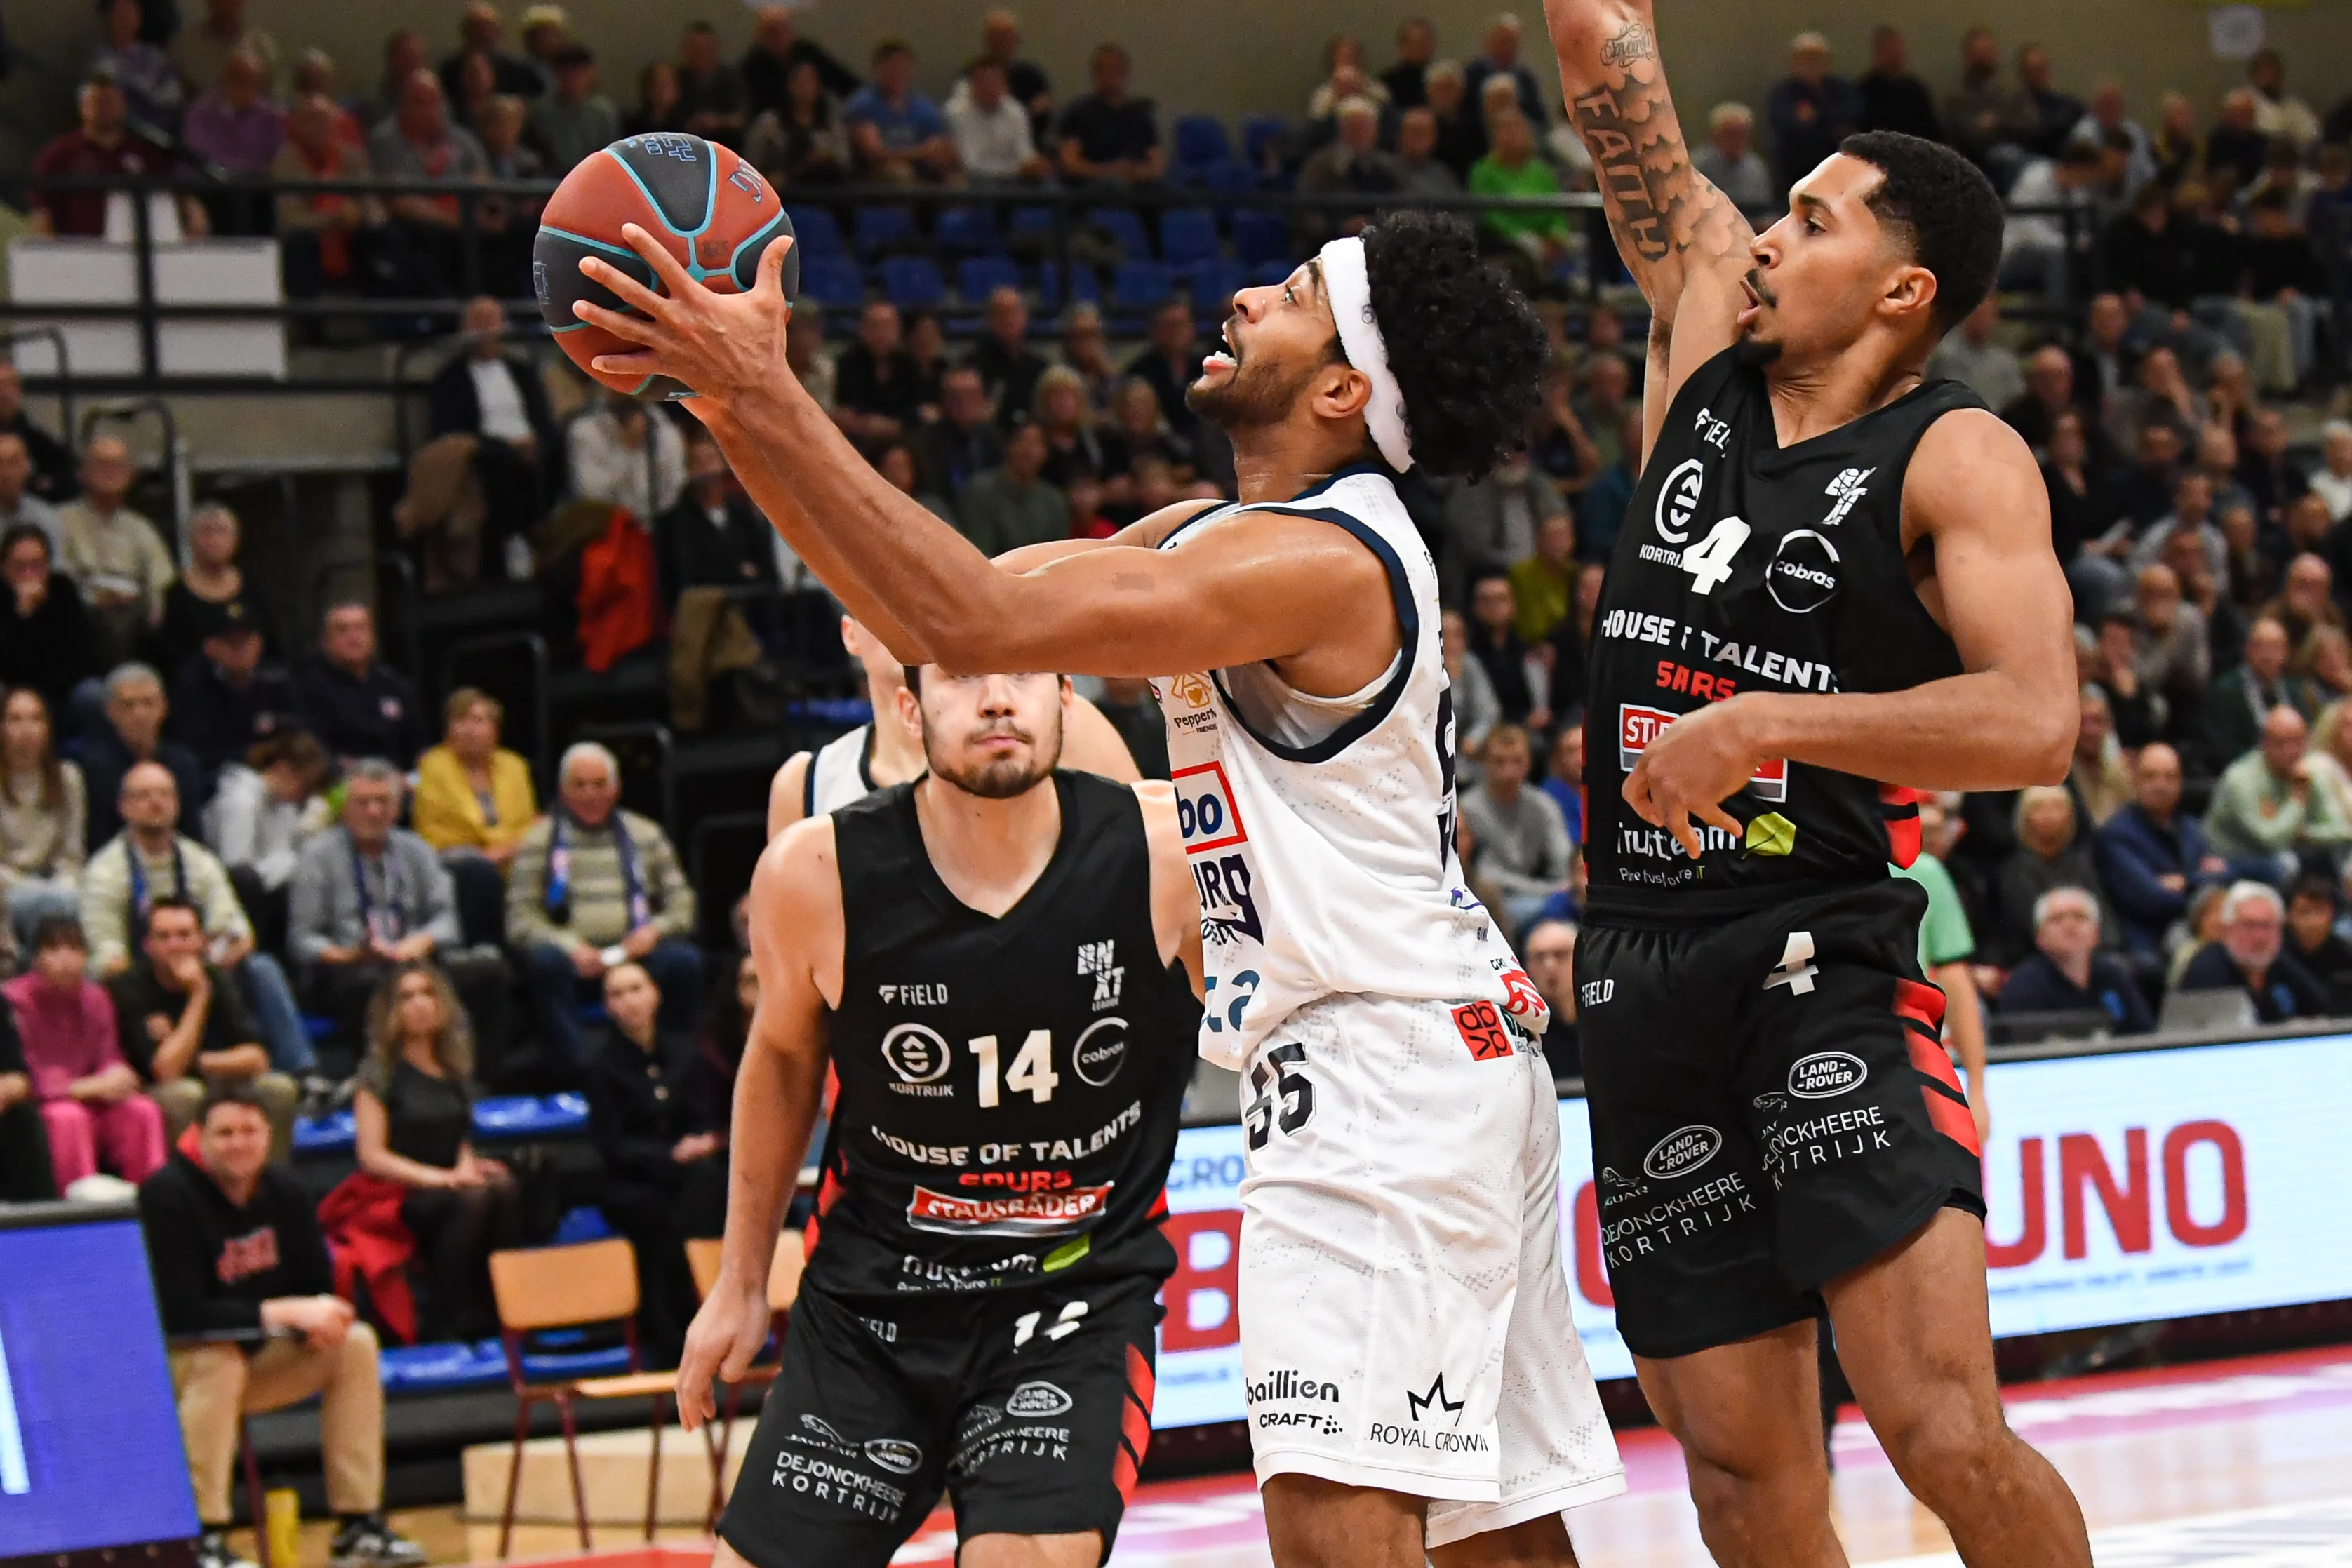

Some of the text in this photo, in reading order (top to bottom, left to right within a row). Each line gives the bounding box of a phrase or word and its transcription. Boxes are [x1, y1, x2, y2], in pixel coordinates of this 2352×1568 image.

[1575, 88, 1668, 255] FAITH
[1639, 544, 1685, 568] KORTRIJ
[1683, 516, 1751, 596] 4
[1775, 561, 1836, 590] cobras
[1601, 609, 1676, 646] HOUSE
[1762, 931, 1819, 996] 4
[968, 1028, 1059, 1108] 14
[980, 1143, 1022, 1165] OF
[1029, 1100, 1141, 1162] TALENTS
[1984, 1118, 2246, 1267] UNO
[1607, 1194, 1756, 1268] KORTRIJK
[1245, 1369, 1339, 1405] baillien
[1259, 1412, 1323, 1428] CRAFT
[1370, 1423, 1430, 1449] ROYAL
